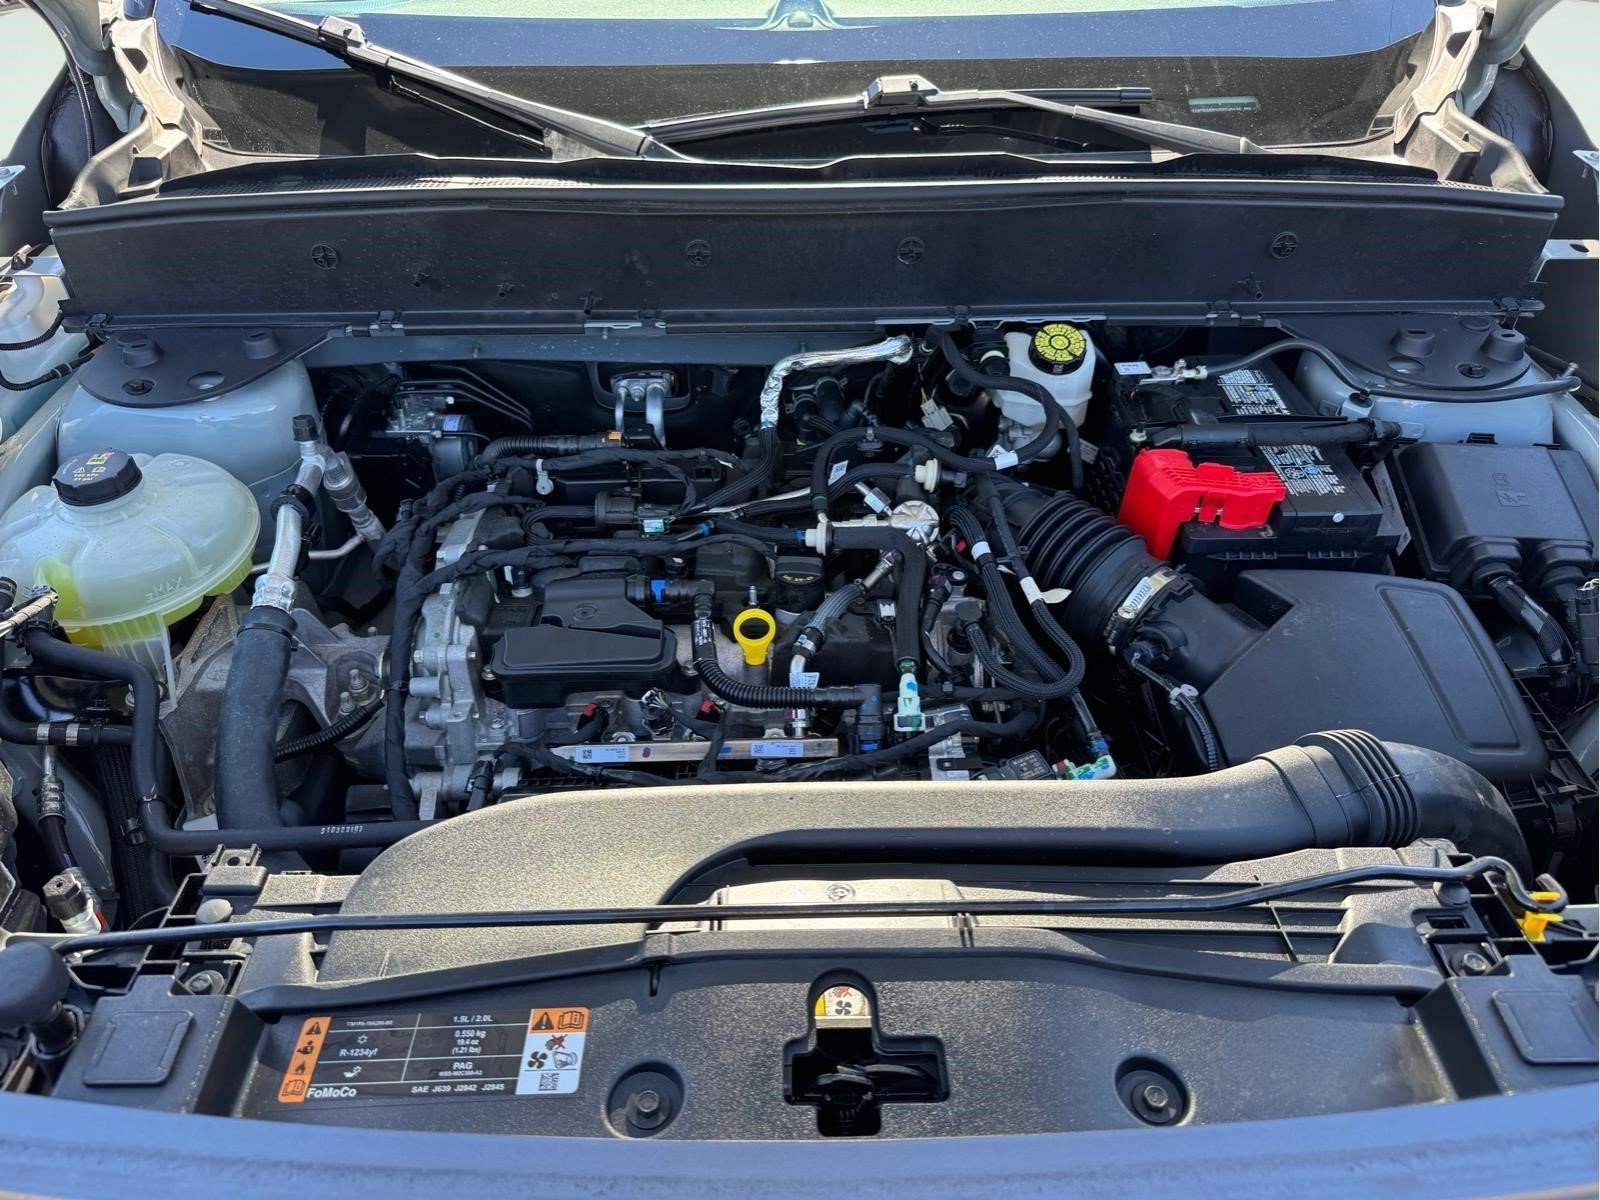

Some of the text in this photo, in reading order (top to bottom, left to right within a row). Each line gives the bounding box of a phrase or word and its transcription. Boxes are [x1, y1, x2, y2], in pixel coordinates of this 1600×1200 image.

[152, 576, 186, 599] MAX
[476, 1030, 487, 1039] kg
[339, 1047, 379, 1058] R-1234yf
[452, 1062, 473, 1070] PAG
[306, 1086, 357, 1098] FoMoCo
[411, 1085, 430, 1093] SAE
